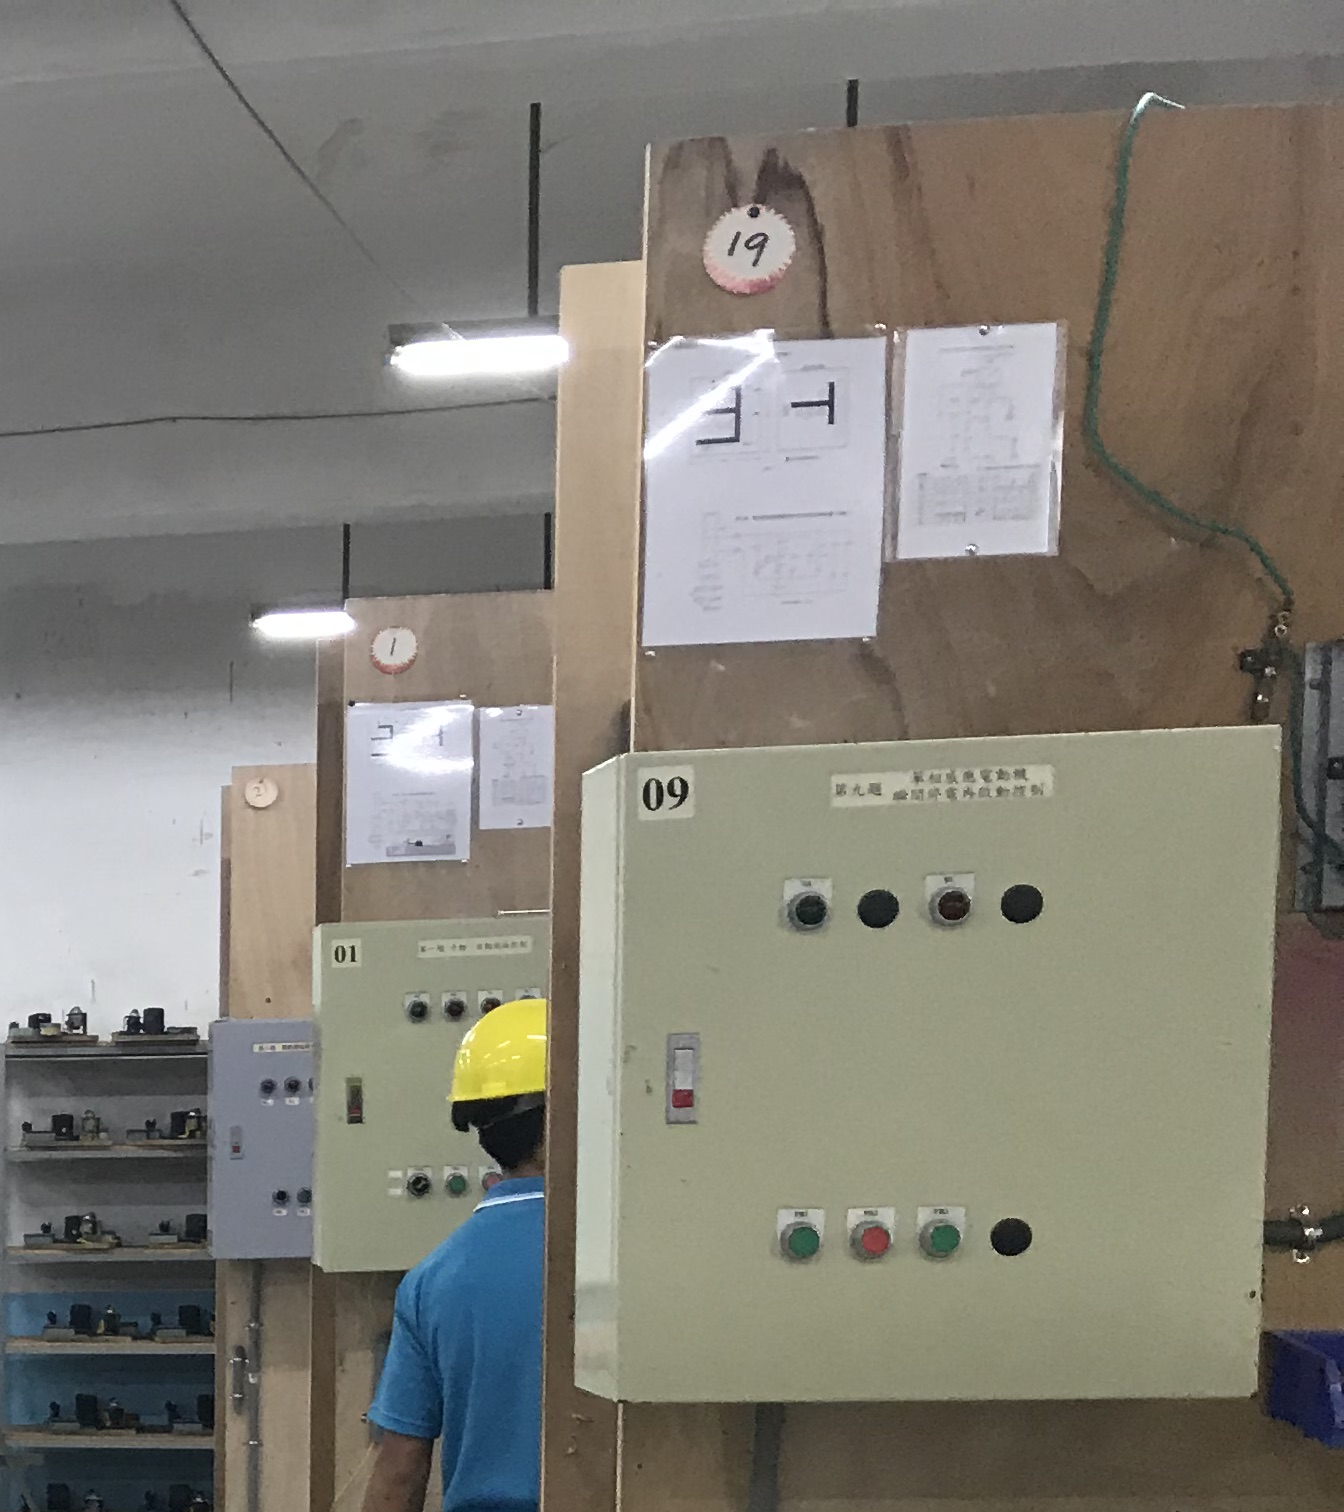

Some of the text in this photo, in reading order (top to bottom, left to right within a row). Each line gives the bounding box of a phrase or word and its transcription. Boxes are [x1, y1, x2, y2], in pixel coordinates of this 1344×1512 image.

[726, 230, 771, 268] 19
[641, 775, 690, 812] 09
[333, 945, 358, 964] 01
